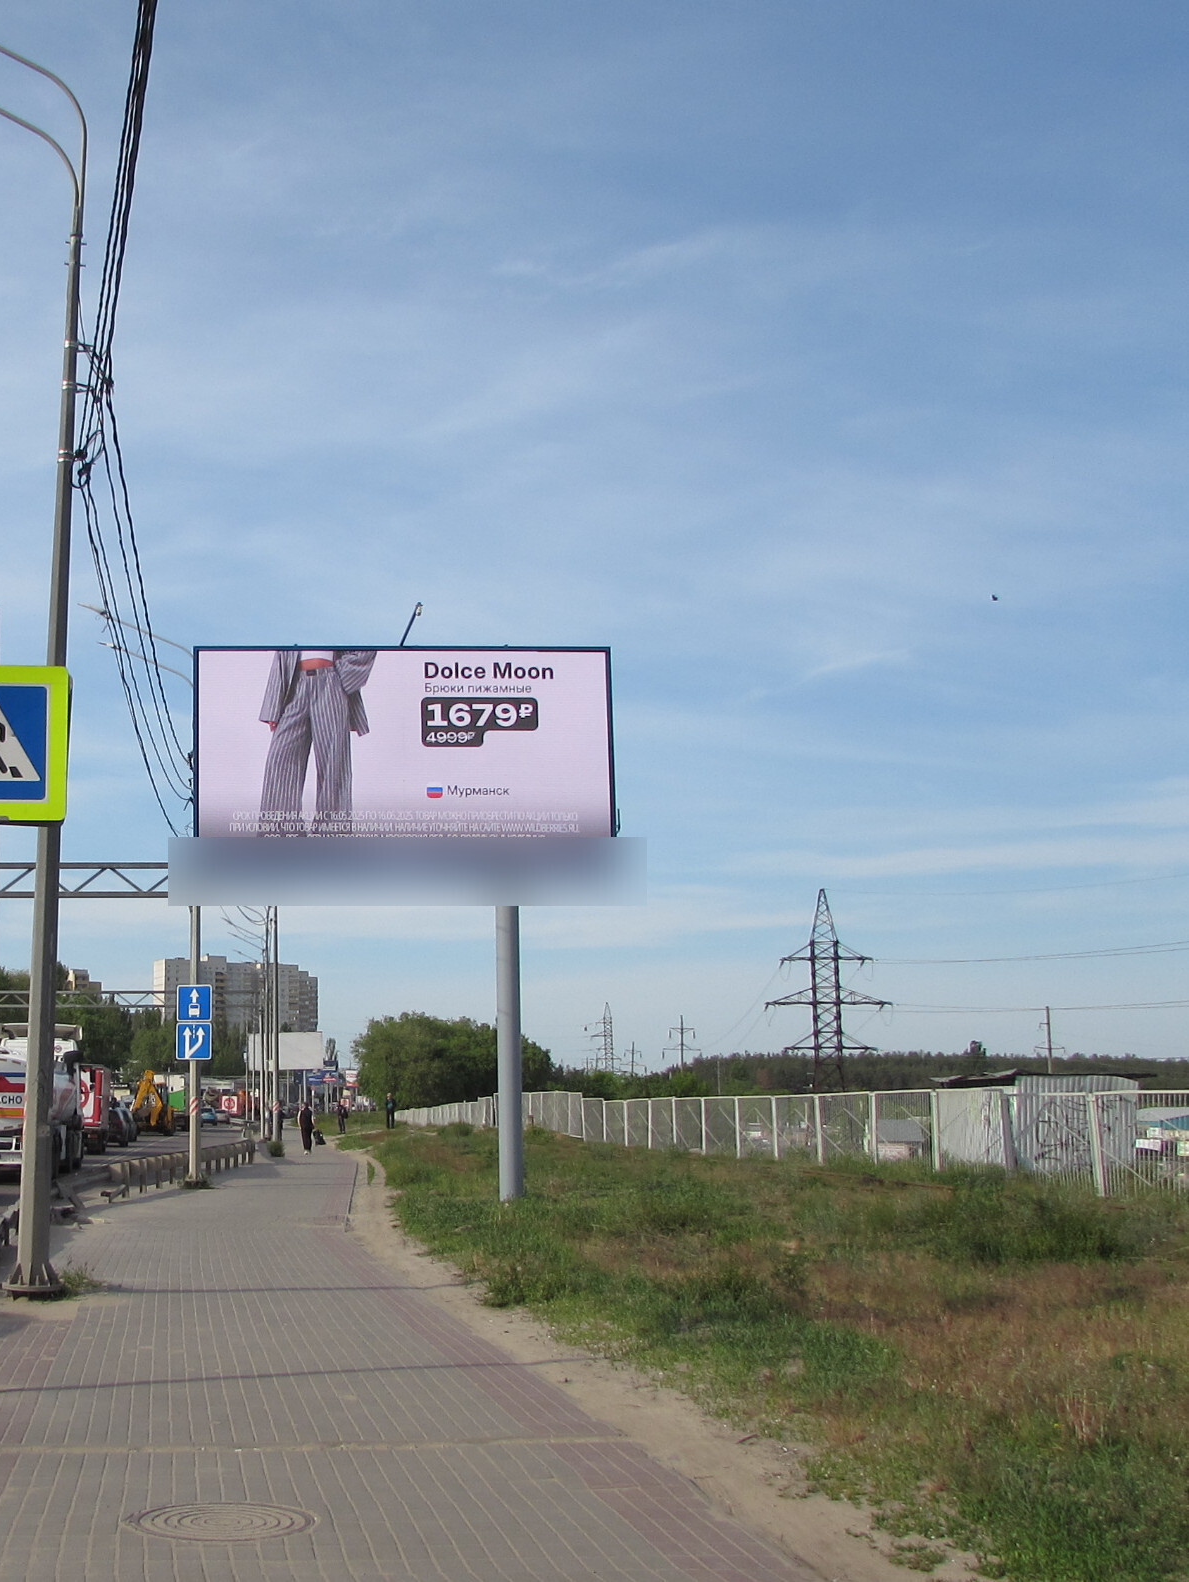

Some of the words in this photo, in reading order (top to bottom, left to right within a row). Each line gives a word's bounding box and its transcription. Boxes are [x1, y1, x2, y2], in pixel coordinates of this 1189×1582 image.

[424, 661, 486, 679] Dolce
[493, 661, 554, 680] Moon
[424, 682, 464, 695] Брюки
[467, 684, 532, 694] пижамные
[426, 702, 534, 728] 1679₽
[447, 785, 510, 798] Мурманск
